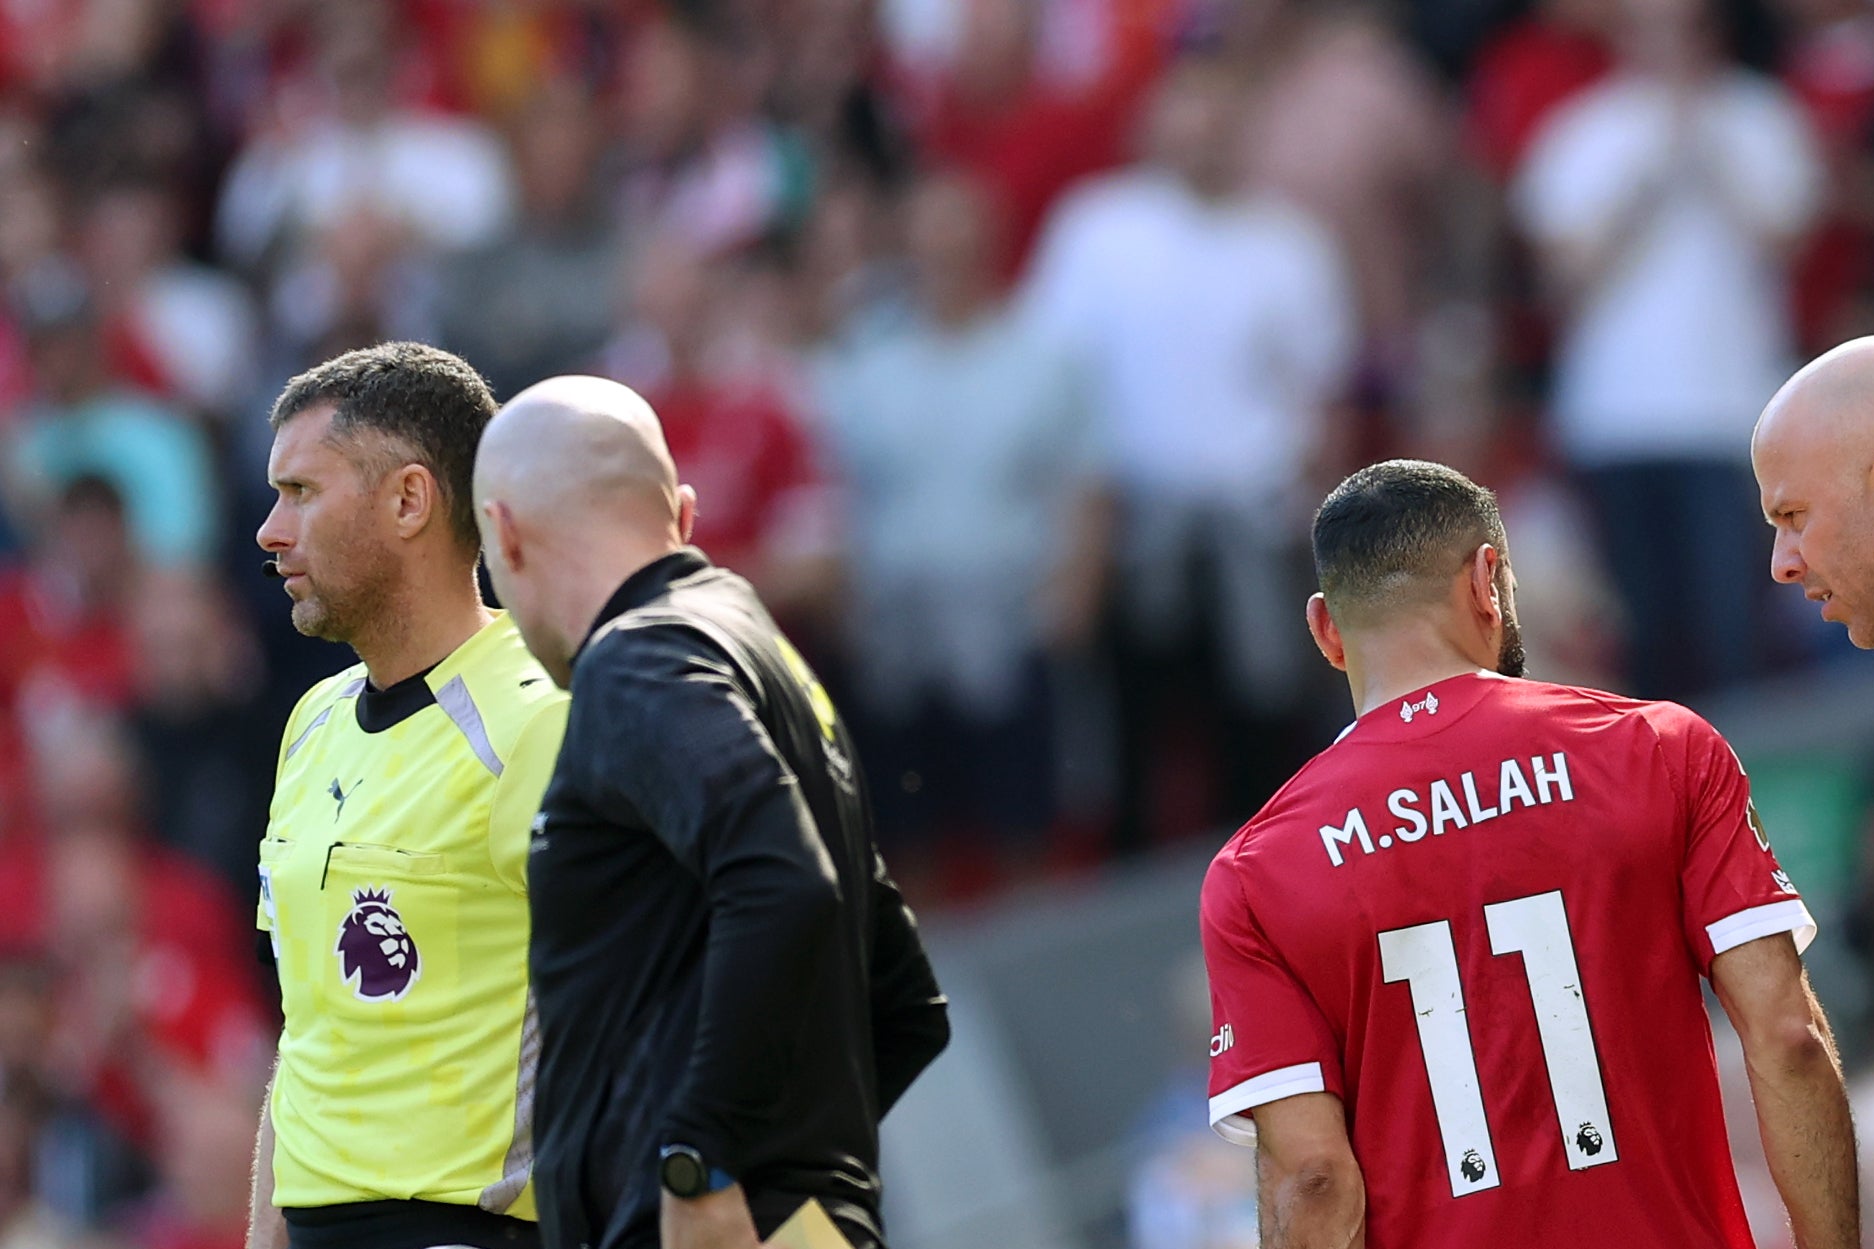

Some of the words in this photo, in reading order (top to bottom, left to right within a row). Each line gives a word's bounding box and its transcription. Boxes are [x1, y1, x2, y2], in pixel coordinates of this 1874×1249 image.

[1412, 700, 1426, 713] 97
[1320, 752, 1574, 866] M.SALAH
[1378, 890, 1617, 1197] 11
